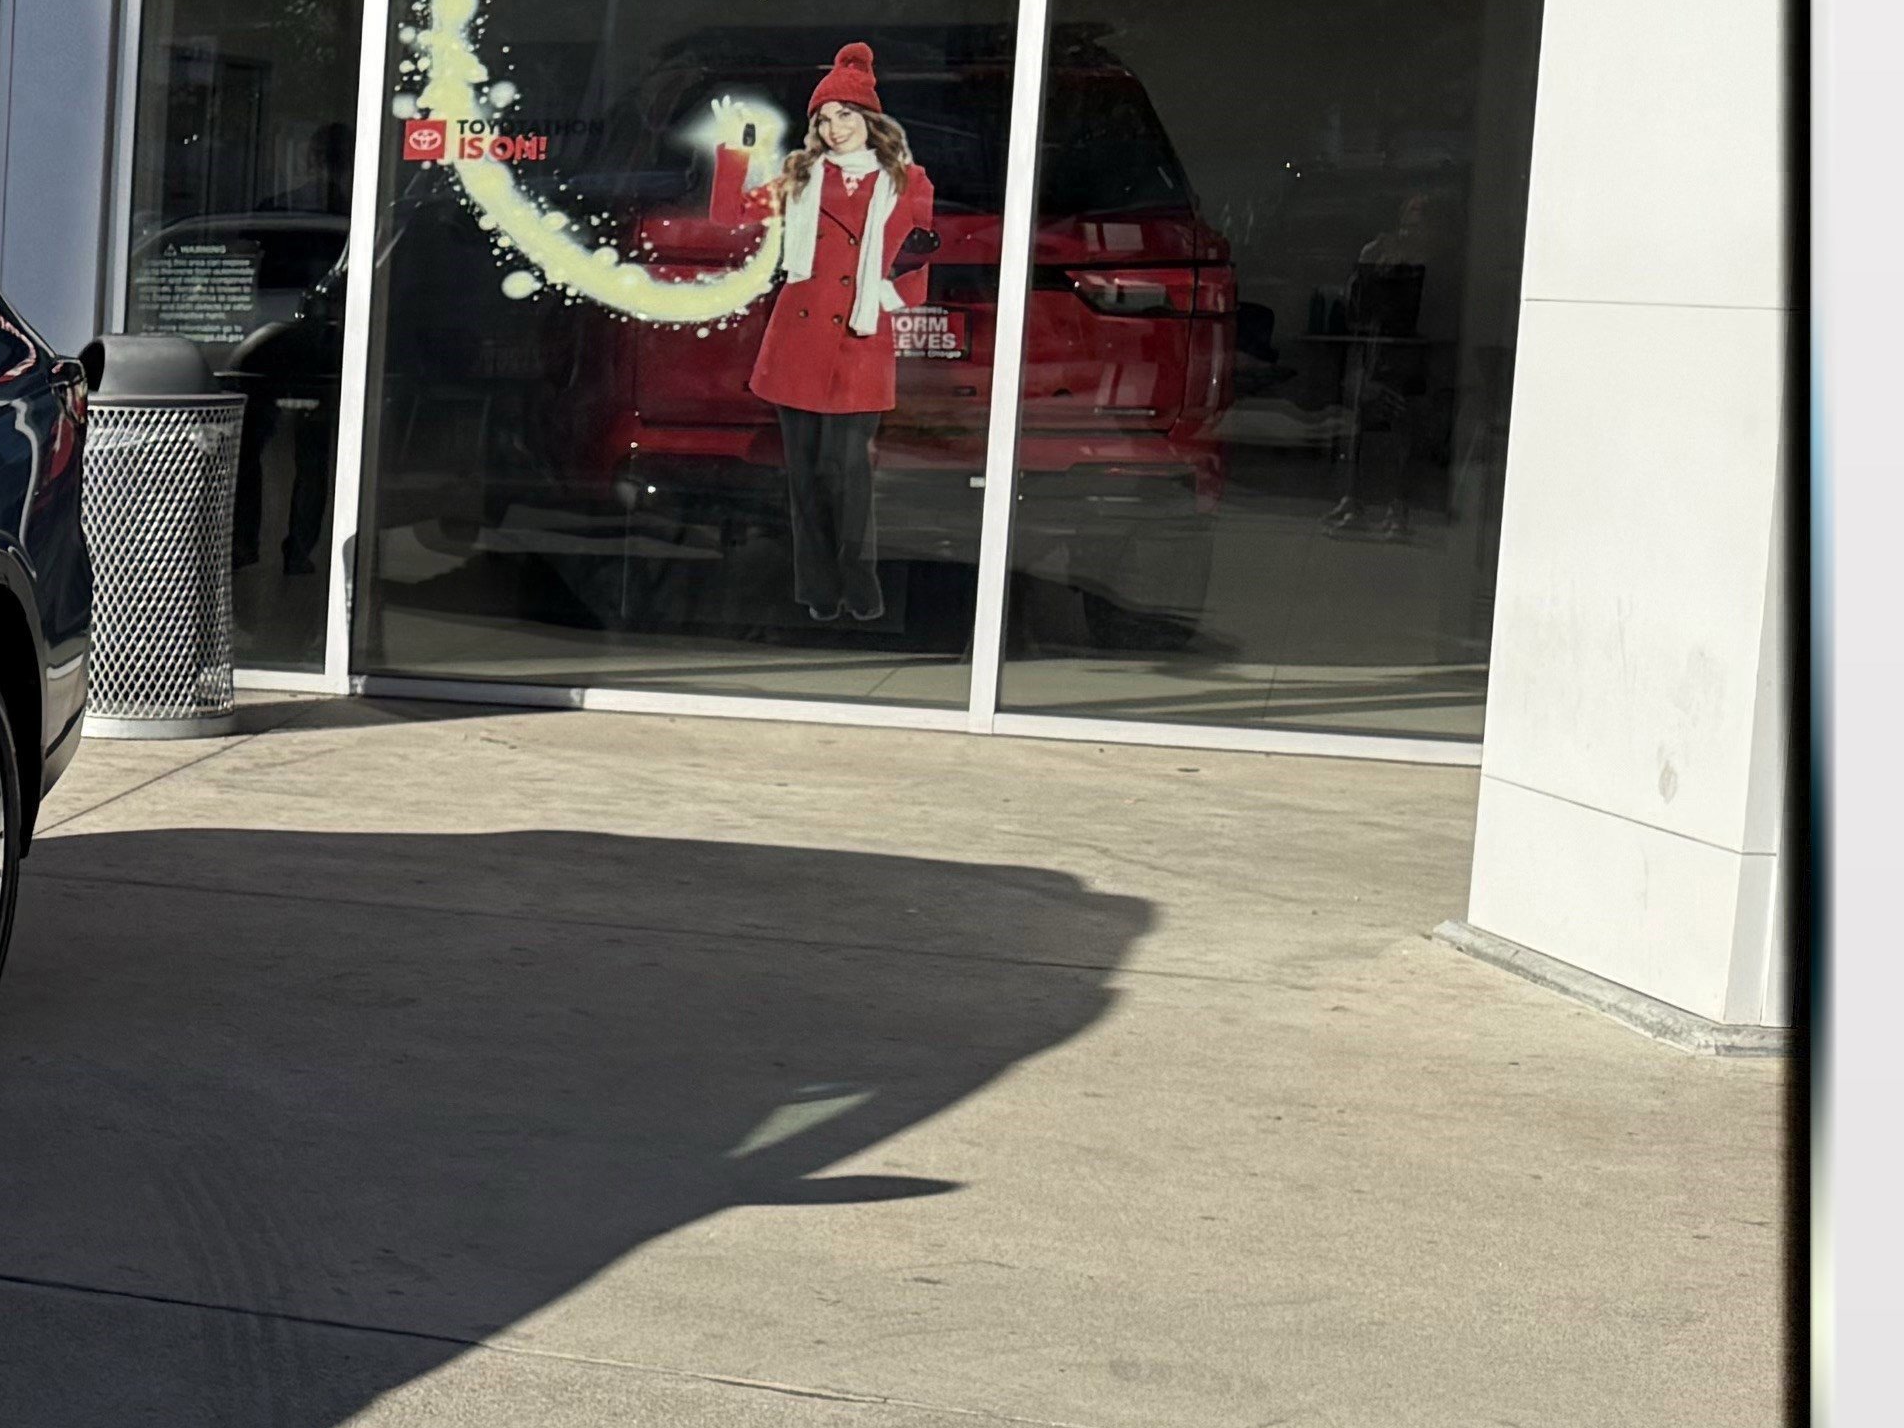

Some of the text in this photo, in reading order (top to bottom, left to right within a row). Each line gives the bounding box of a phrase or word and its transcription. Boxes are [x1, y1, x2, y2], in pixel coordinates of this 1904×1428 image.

[458, 135, 549, 163] IS ON!
[892, 315, 948, 332] ORM
[893, 333, 956, 350] EVES
